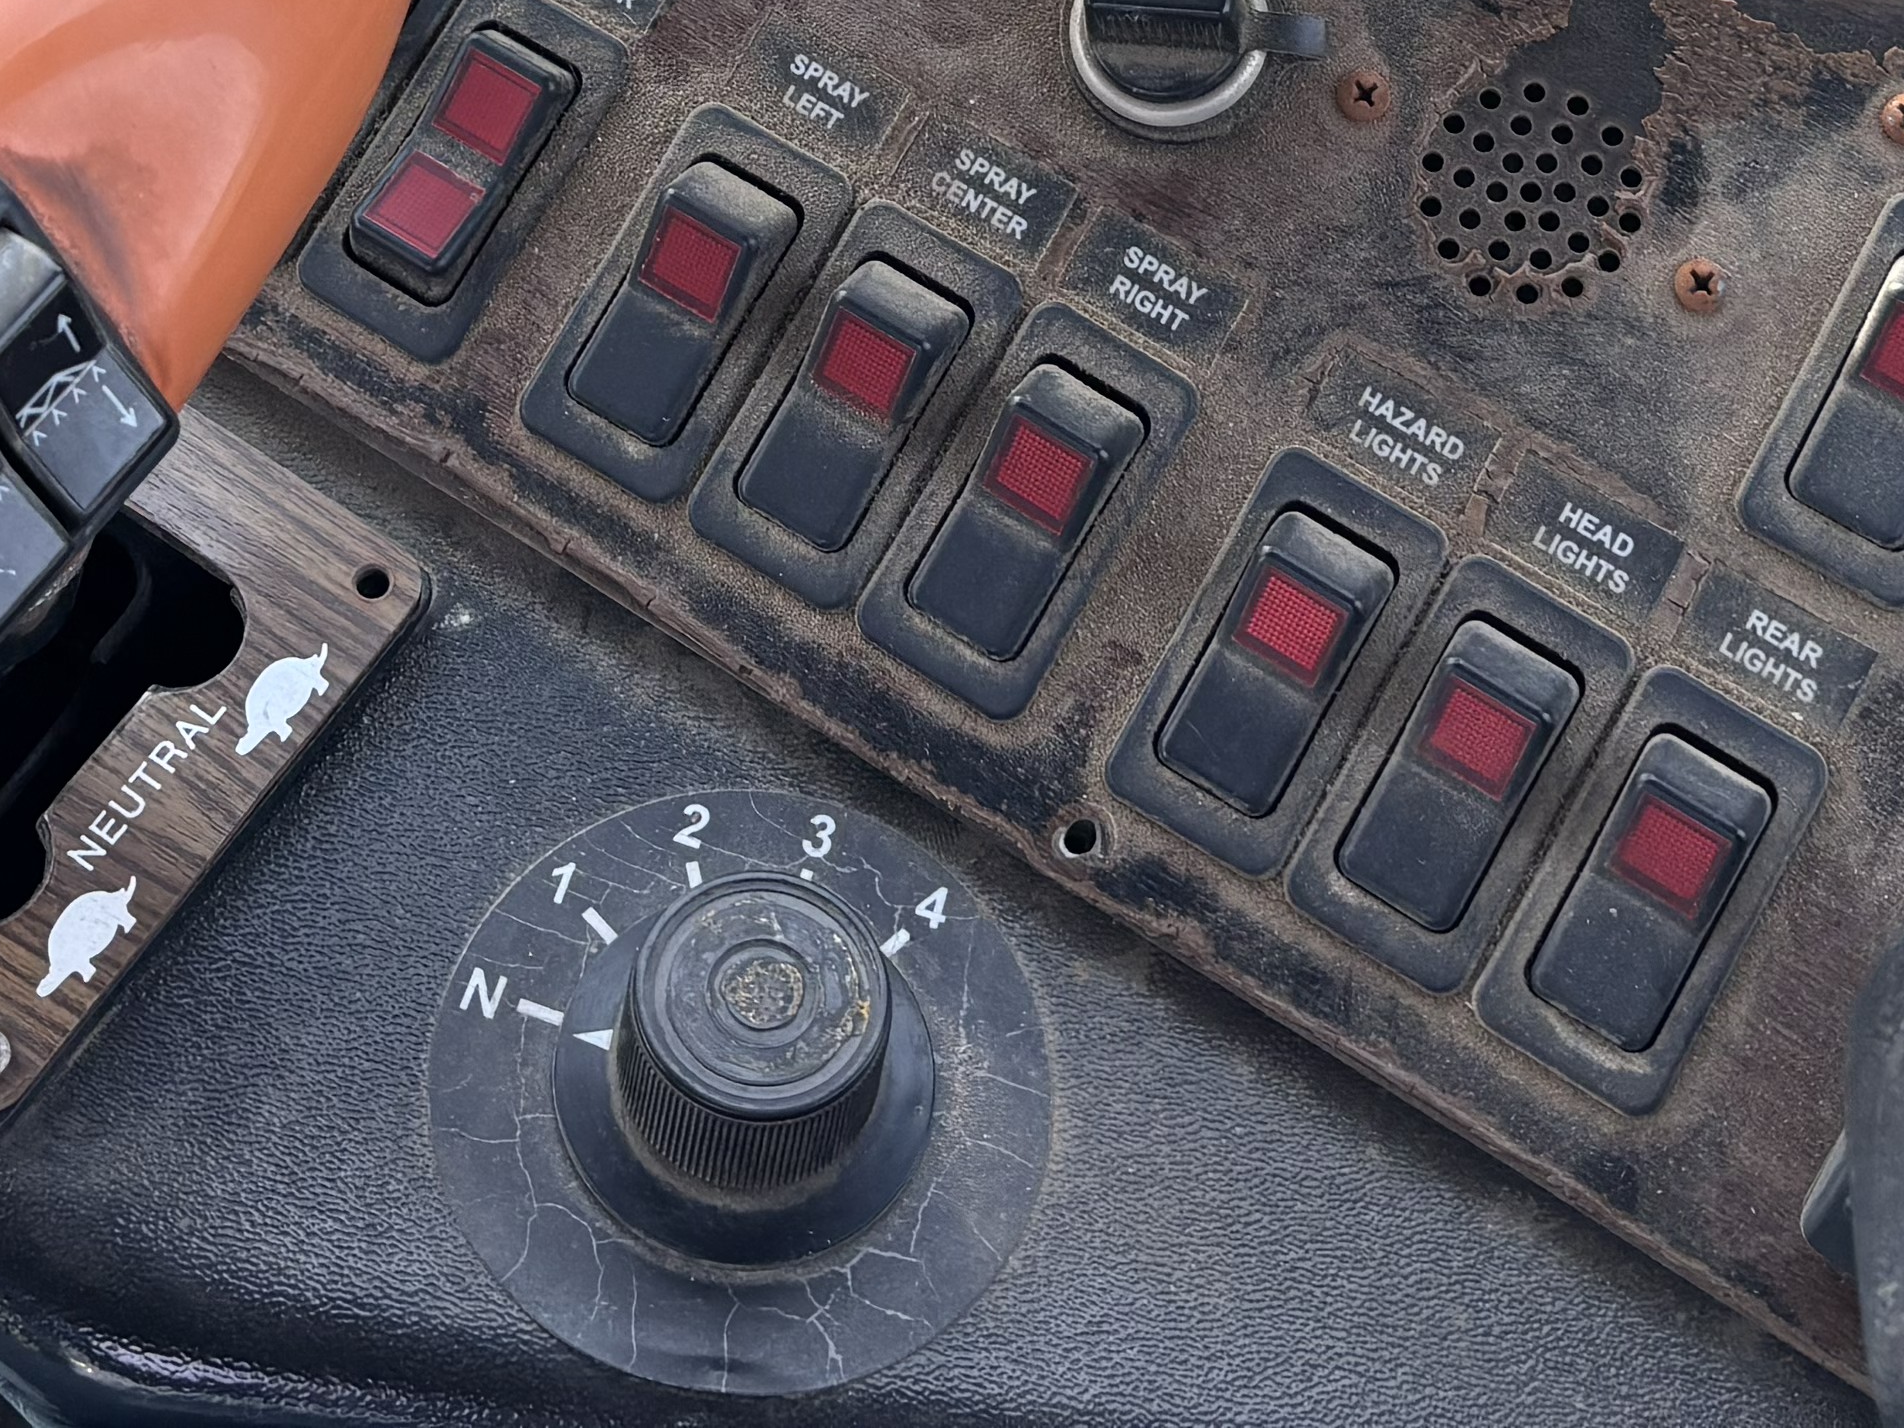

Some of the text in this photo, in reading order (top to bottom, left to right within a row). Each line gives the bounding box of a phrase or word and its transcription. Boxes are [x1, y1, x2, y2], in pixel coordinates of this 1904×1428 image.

[783, 84, 845, 131] LEFT
[789, 53, 870, 110] SPRAY
[930, 171, 1029, 242] CENTER
[954, 147, 1036, 207] SPRAY
[1108, 273, 1190, 333] RIGHT
[1122, 245, 1207, 304] SPRAY
[1349, 418, 1443, 487] LIGHTS
[1357, 384, 1465, 463] HAZARD
[1533, 528, 1630, 596] LIGHTS
[1559, 500, 1637, 560] HEAD
[1718, 634, 1817, 703] LIGHTS
[1746, 606, 1824, 668] REAR
[66, 691, 229, 872] NEUTRAL
[459, 804, 949, 1019] N 1 2 3 4
